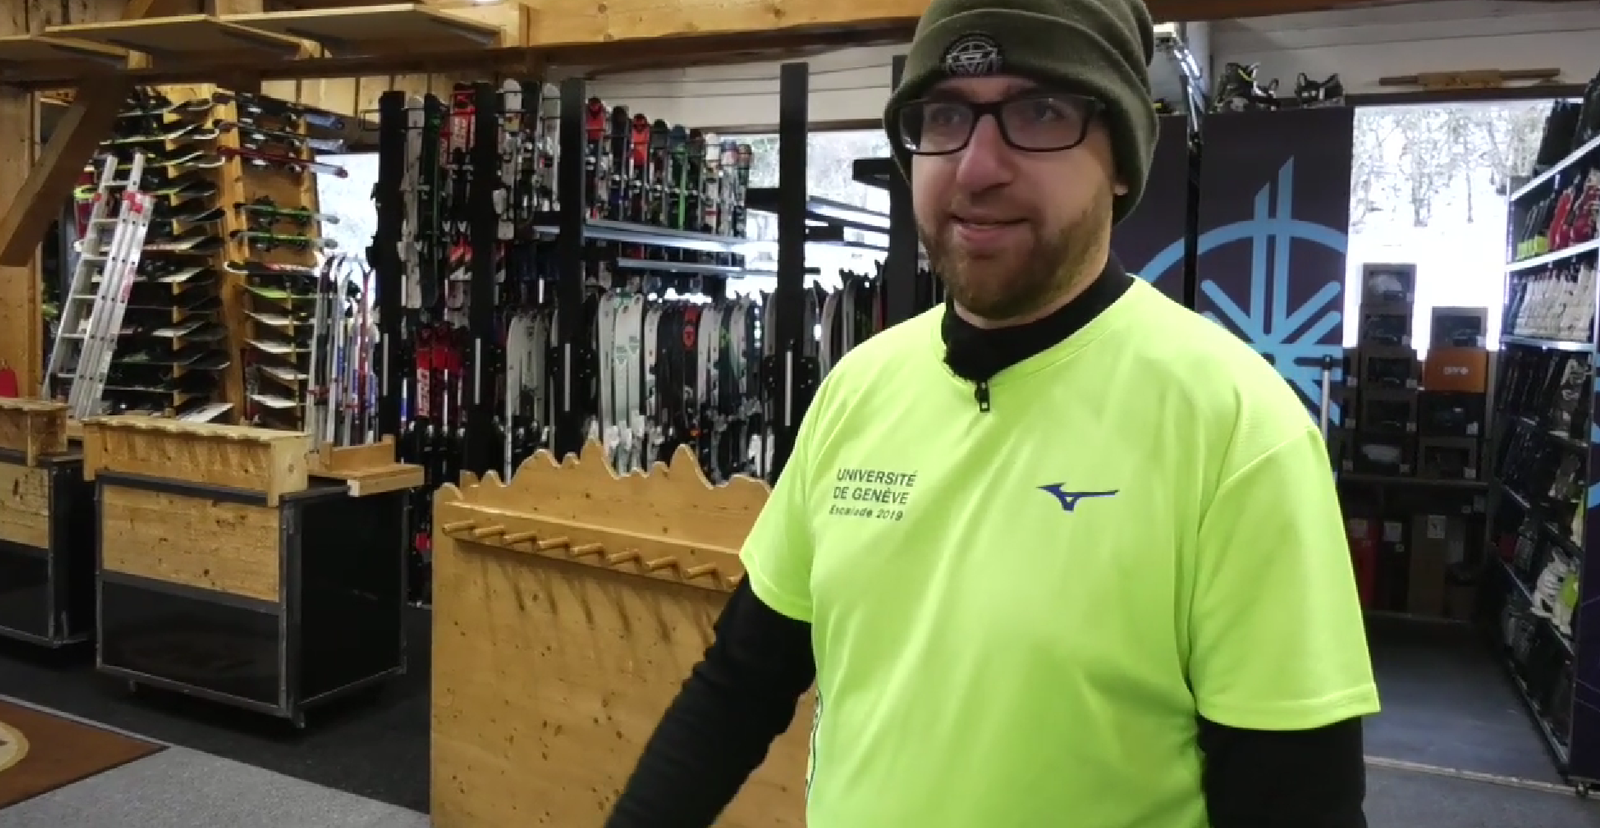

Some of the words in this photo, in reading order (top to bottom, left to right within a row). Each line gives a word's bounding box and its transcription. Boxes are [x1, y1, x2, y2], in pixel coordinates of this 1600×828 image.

[836, 468, 918, 487] UNIVERSITÉ
[833, 486, 849, 499] DE
[851, 486, 911, 504] GENÈVE
[829, 505, 873, 518] Escalade
[875, 508, 904, 521] 2019
